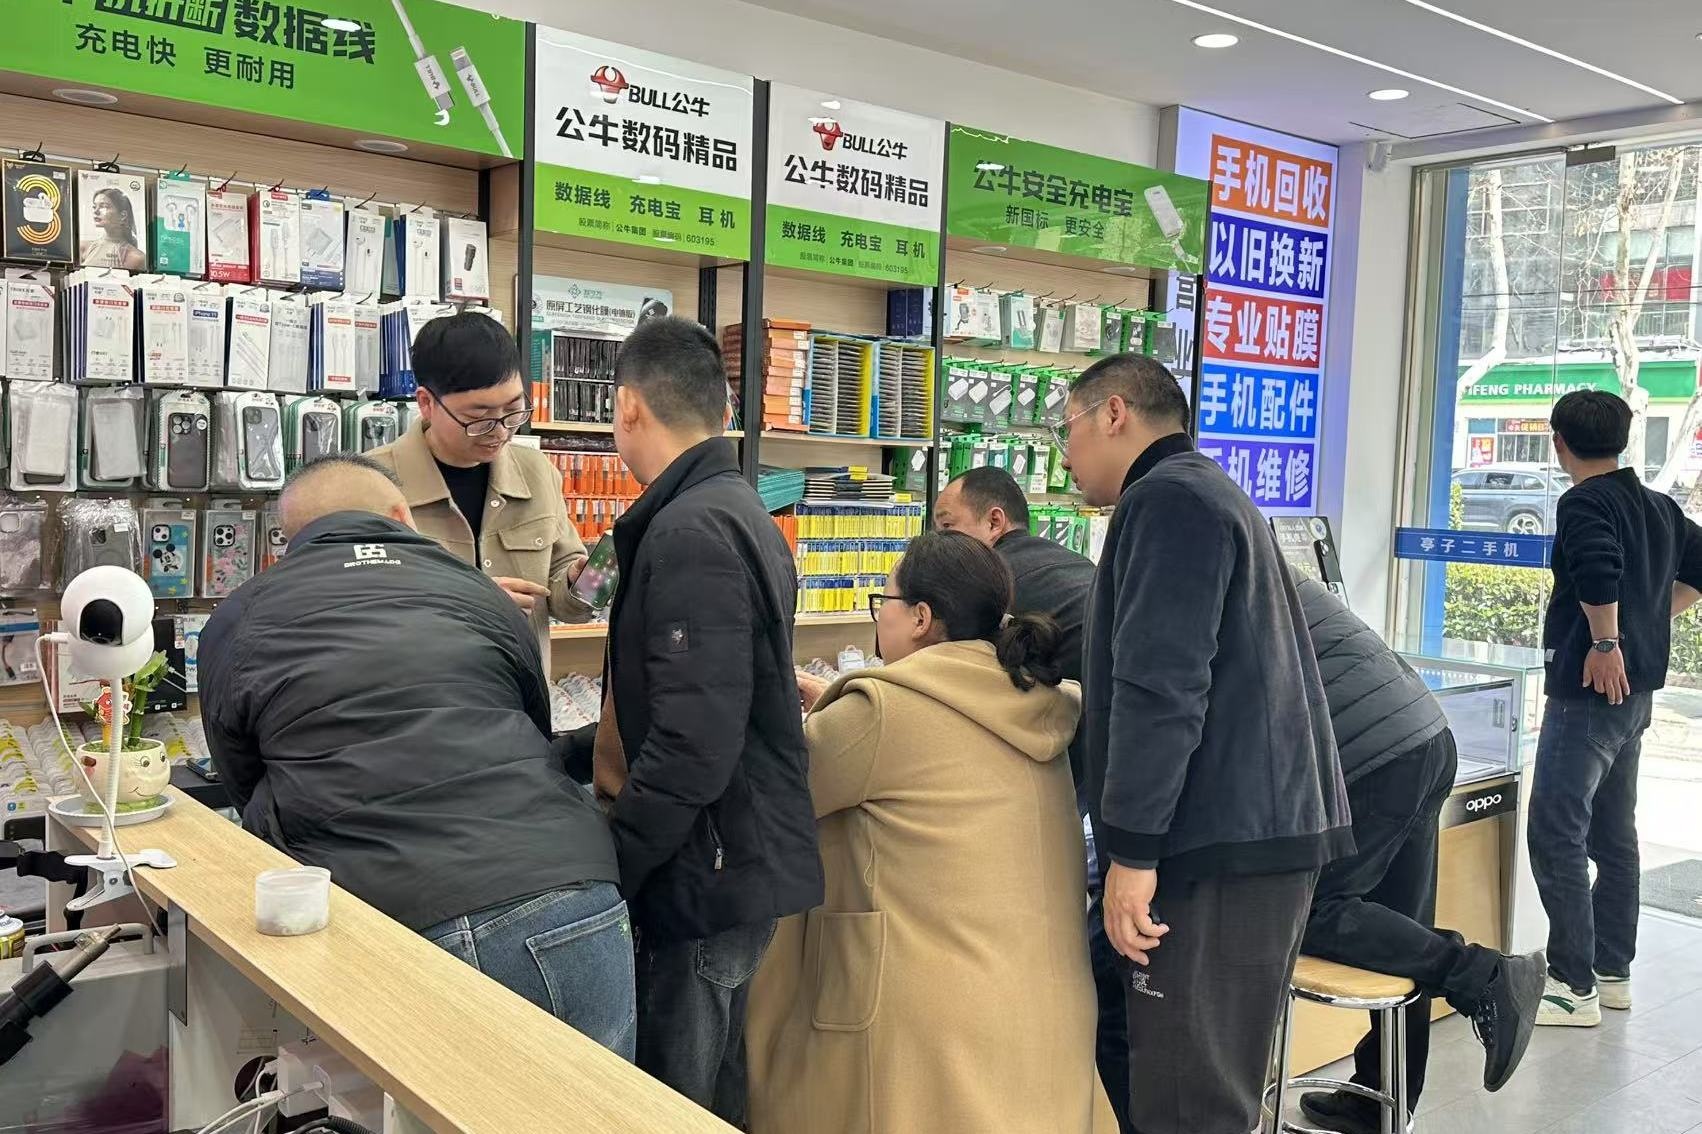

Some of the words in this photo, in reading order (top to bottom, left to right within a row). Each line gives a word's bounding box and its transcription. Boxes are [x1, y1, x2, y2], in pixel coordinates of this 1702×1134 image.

[75, 23, 177, 67] 充电快
[204, 47, 295, 89] 更耐用
[628, 84, 711, 117] BULL公牛
[555, 106, 737, 172] 公牛数码精品
[842, 133, 908, 160] BULL公牛
[554, 181, 611, 209] 数据线
[629, 195, 681, 220] 充电宝
[698, 206, 736, 229] 耳机
[784, 154, 929, 208] 公牛数码精品
[973, 159, 1134, 218] 公牛安全充电宝
[1213, 146, 1330, 222] 手机回收
[616, 224, 646, 236] 公牛集团
[686, 234, 715, 246] 603195
[782, 221, 826, 244] 数据线
[840, 230, 882, 252] 充电宝
[895, 239, 925, 259] 耳机
[1005, 204, 1049, 230] 新国标
[1065, 215, 1105, 240] 更安全
[1208, 221, 1324, 292] 以旧换新
[1205, 295, 1321, 363] 专业贴膜
[1200, 371, 1315, 434] 手机配件
